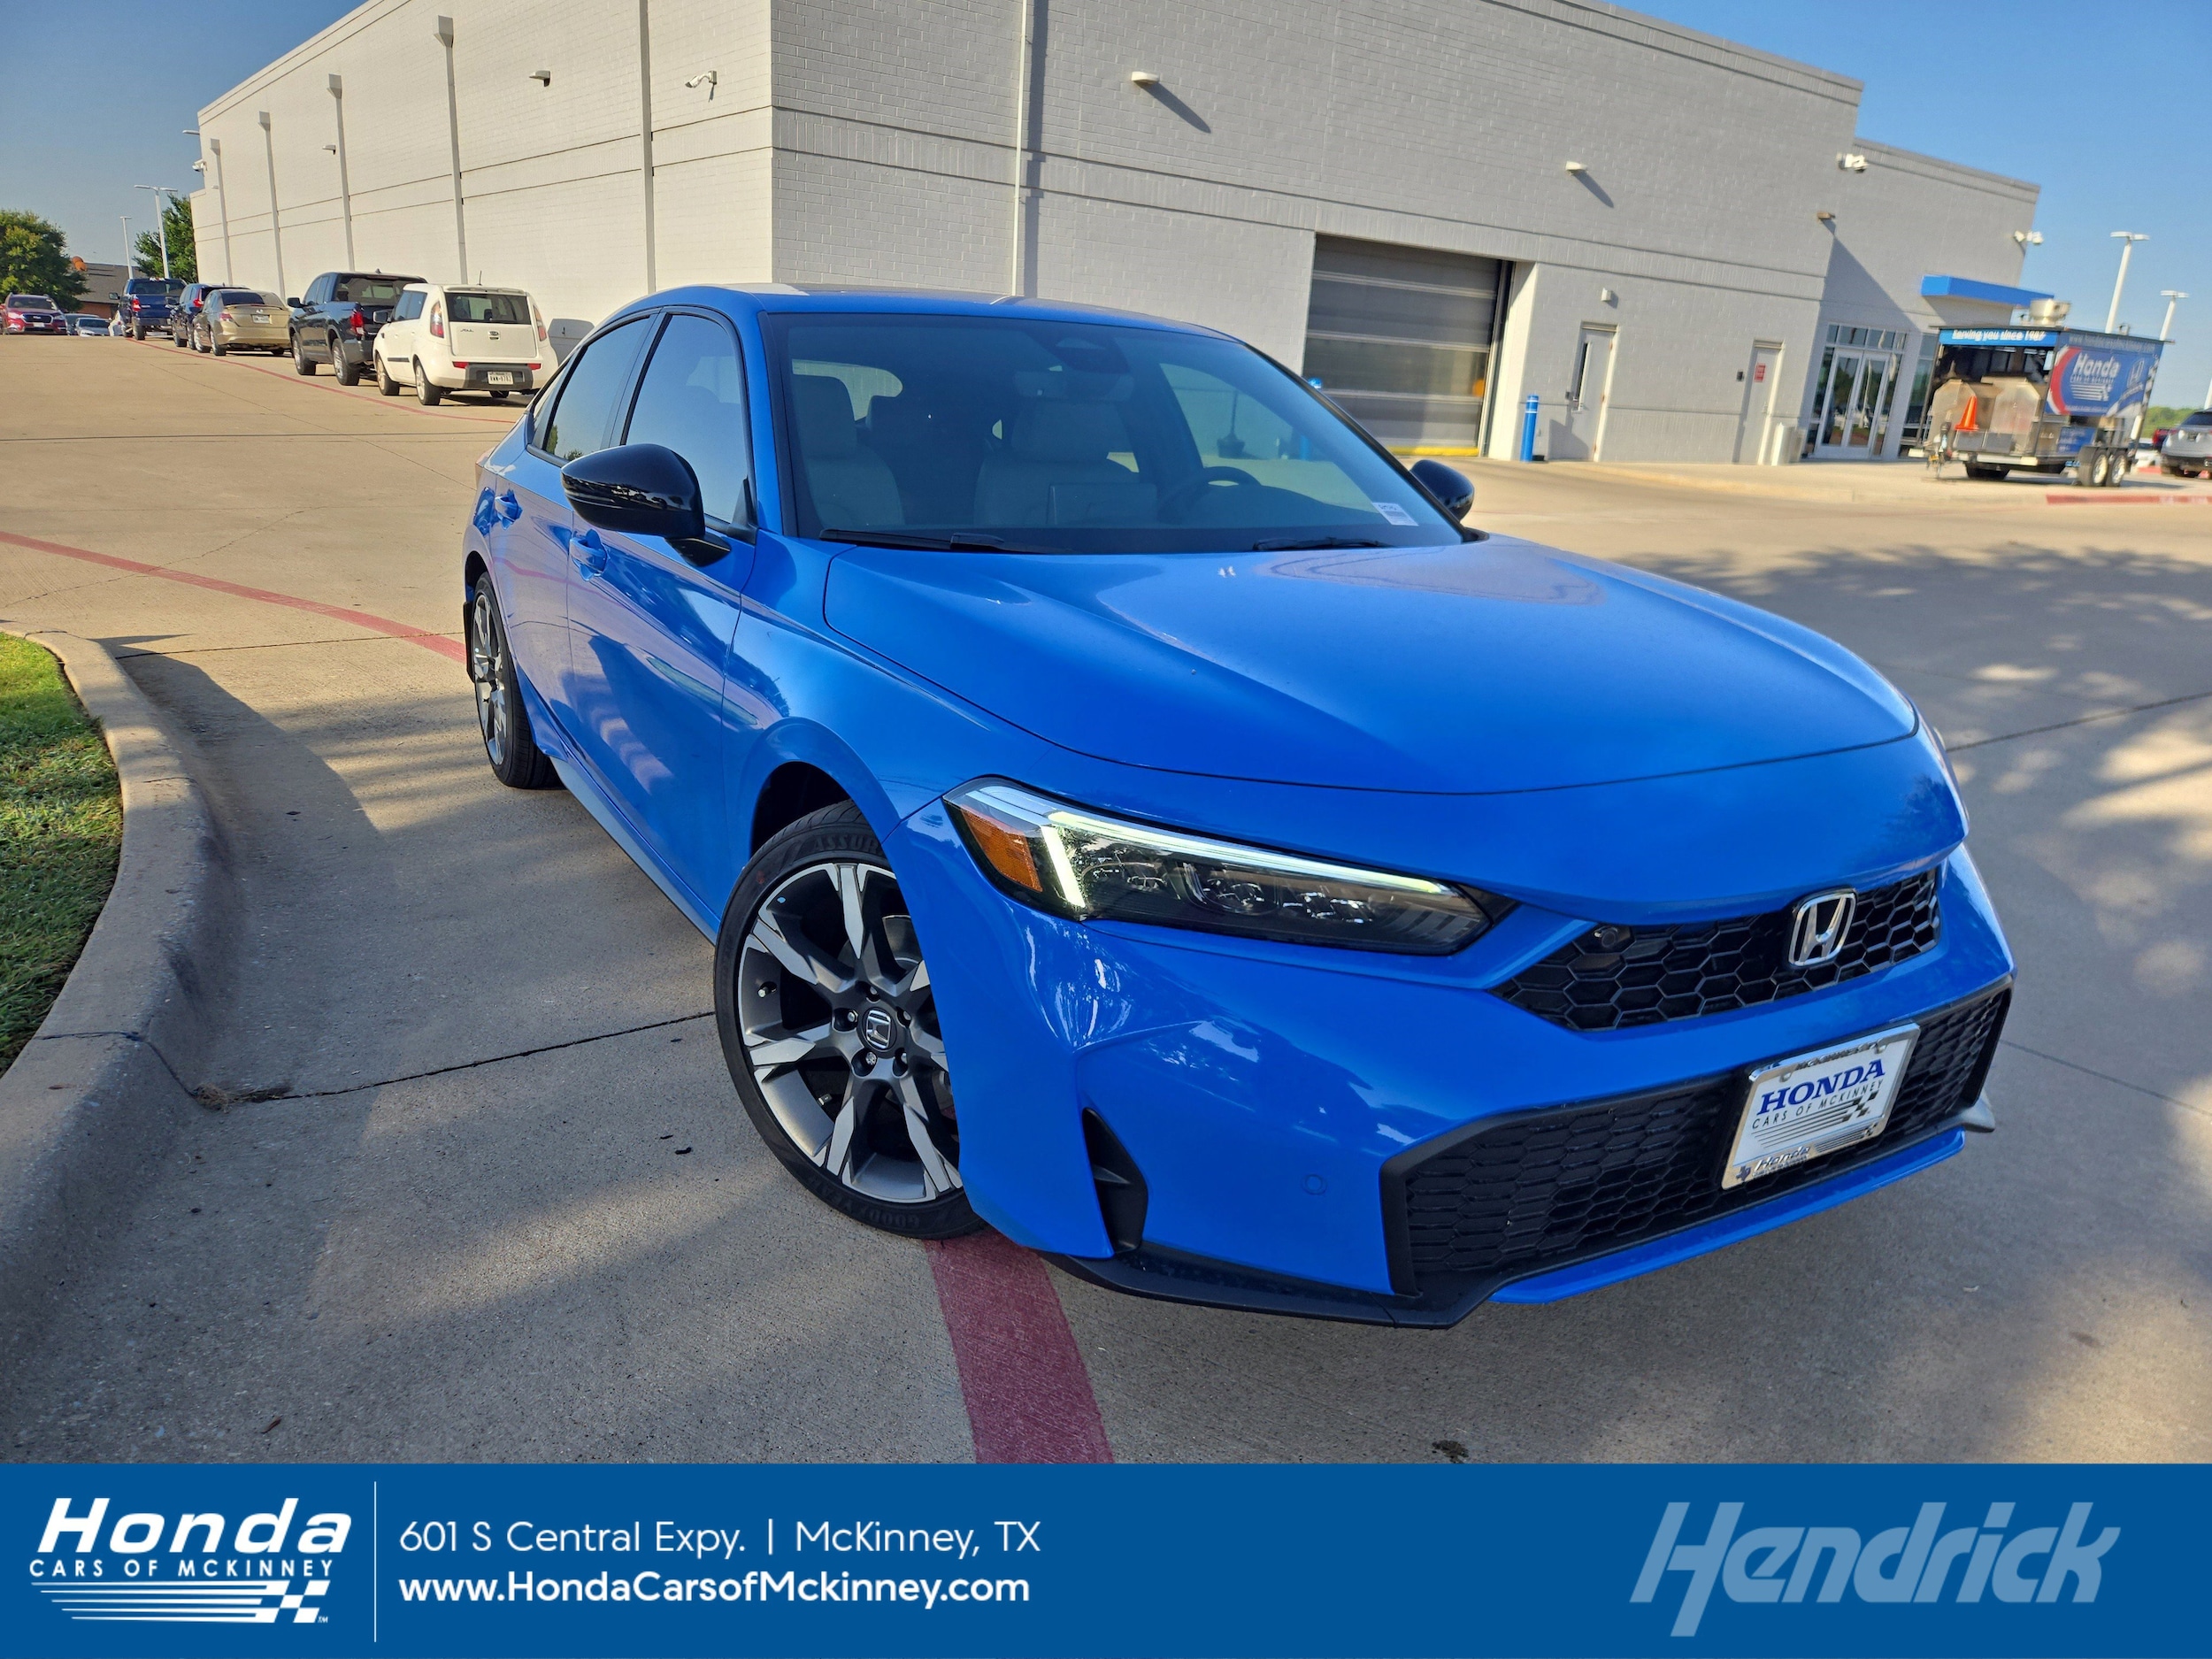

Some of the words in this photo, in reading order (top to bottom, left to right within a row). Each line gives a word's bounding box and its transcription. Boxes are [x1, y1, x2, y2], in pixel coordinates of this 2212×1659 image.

[2072, 352, 2120, 378] Honda
[1752, 1110, 1787, 1130] CARS
[1795, 1103, 1812, 1117] OF
[1818, 1079, 1884, 1110] MCKINNEY
[1756, 1058, 1886, 1116] HONDA
